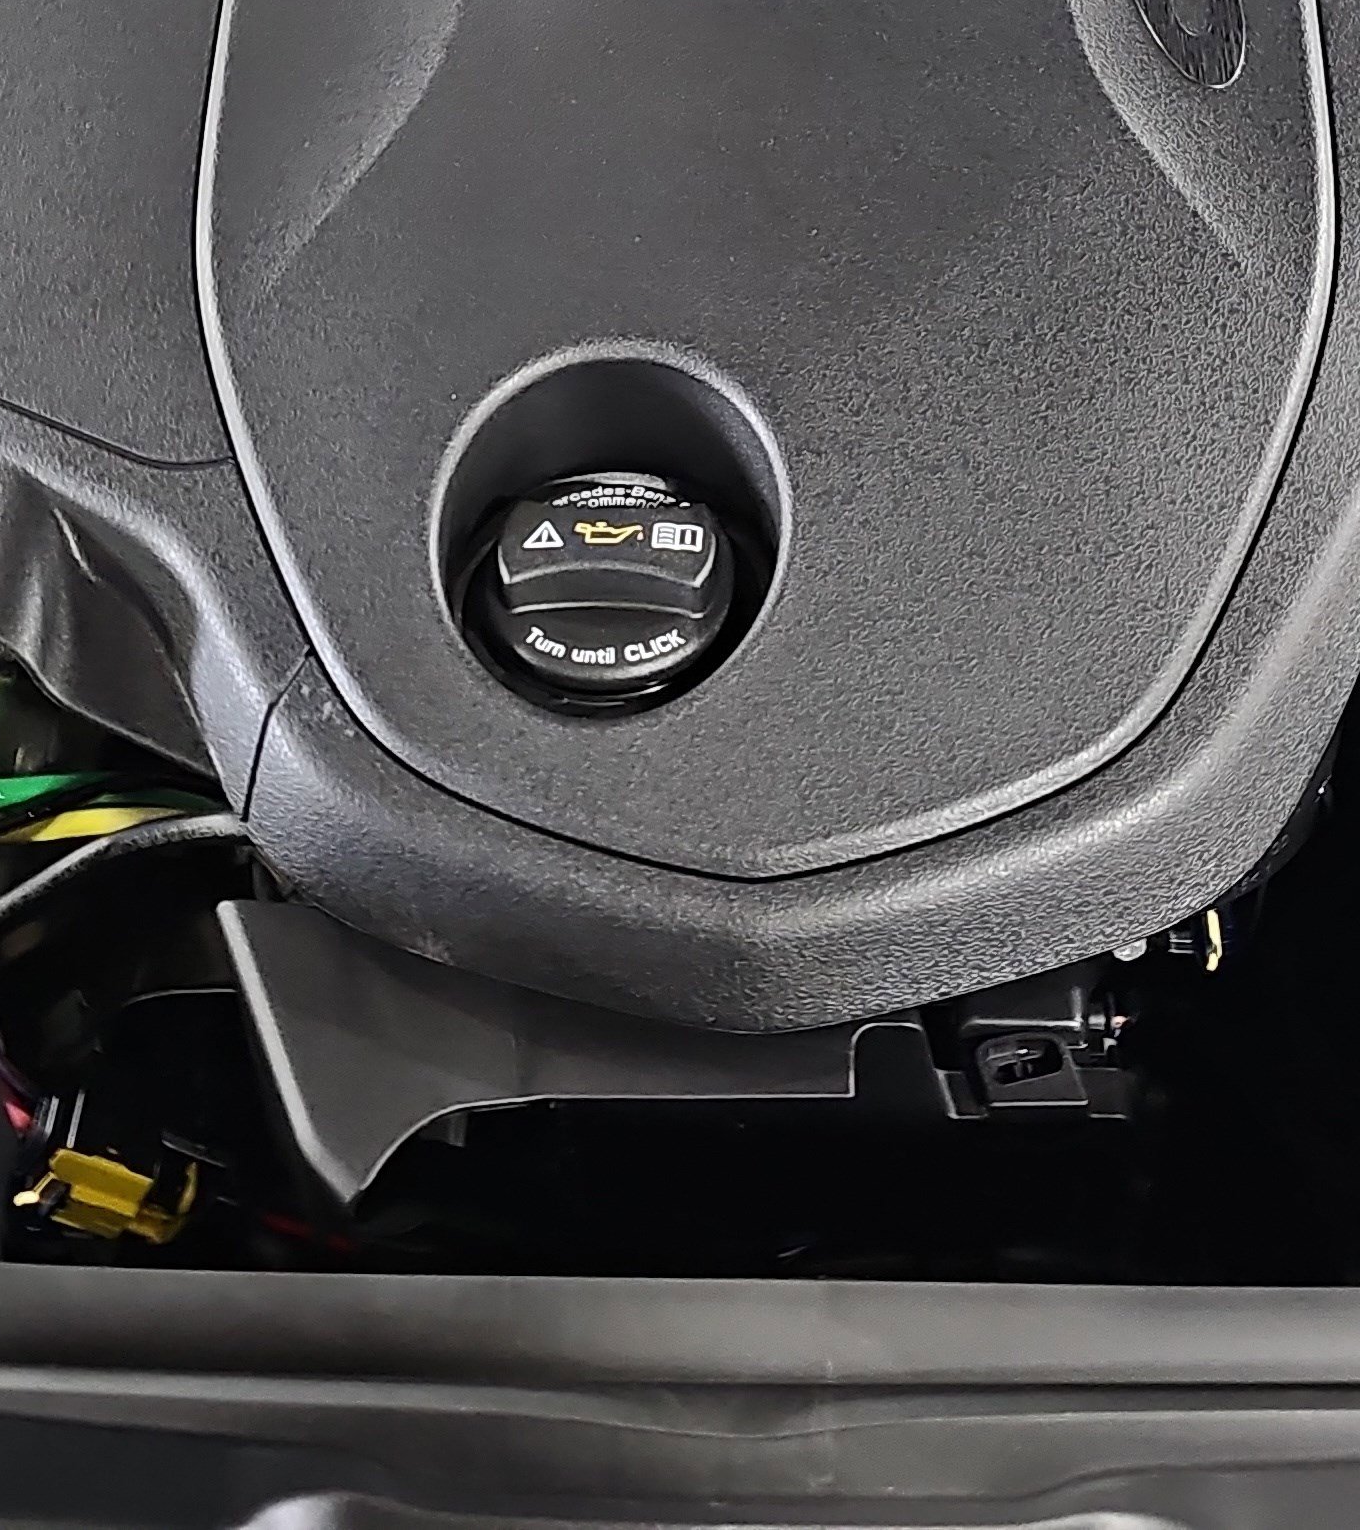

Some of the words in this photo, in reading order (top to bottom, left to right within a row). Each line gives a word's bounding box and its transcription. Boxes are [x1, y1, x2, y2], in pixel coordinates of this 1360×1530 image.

[525, 626, 567, 658] Turn
[571, 646, 616, 665] until
[624, 628, 687, 662] CLICK
